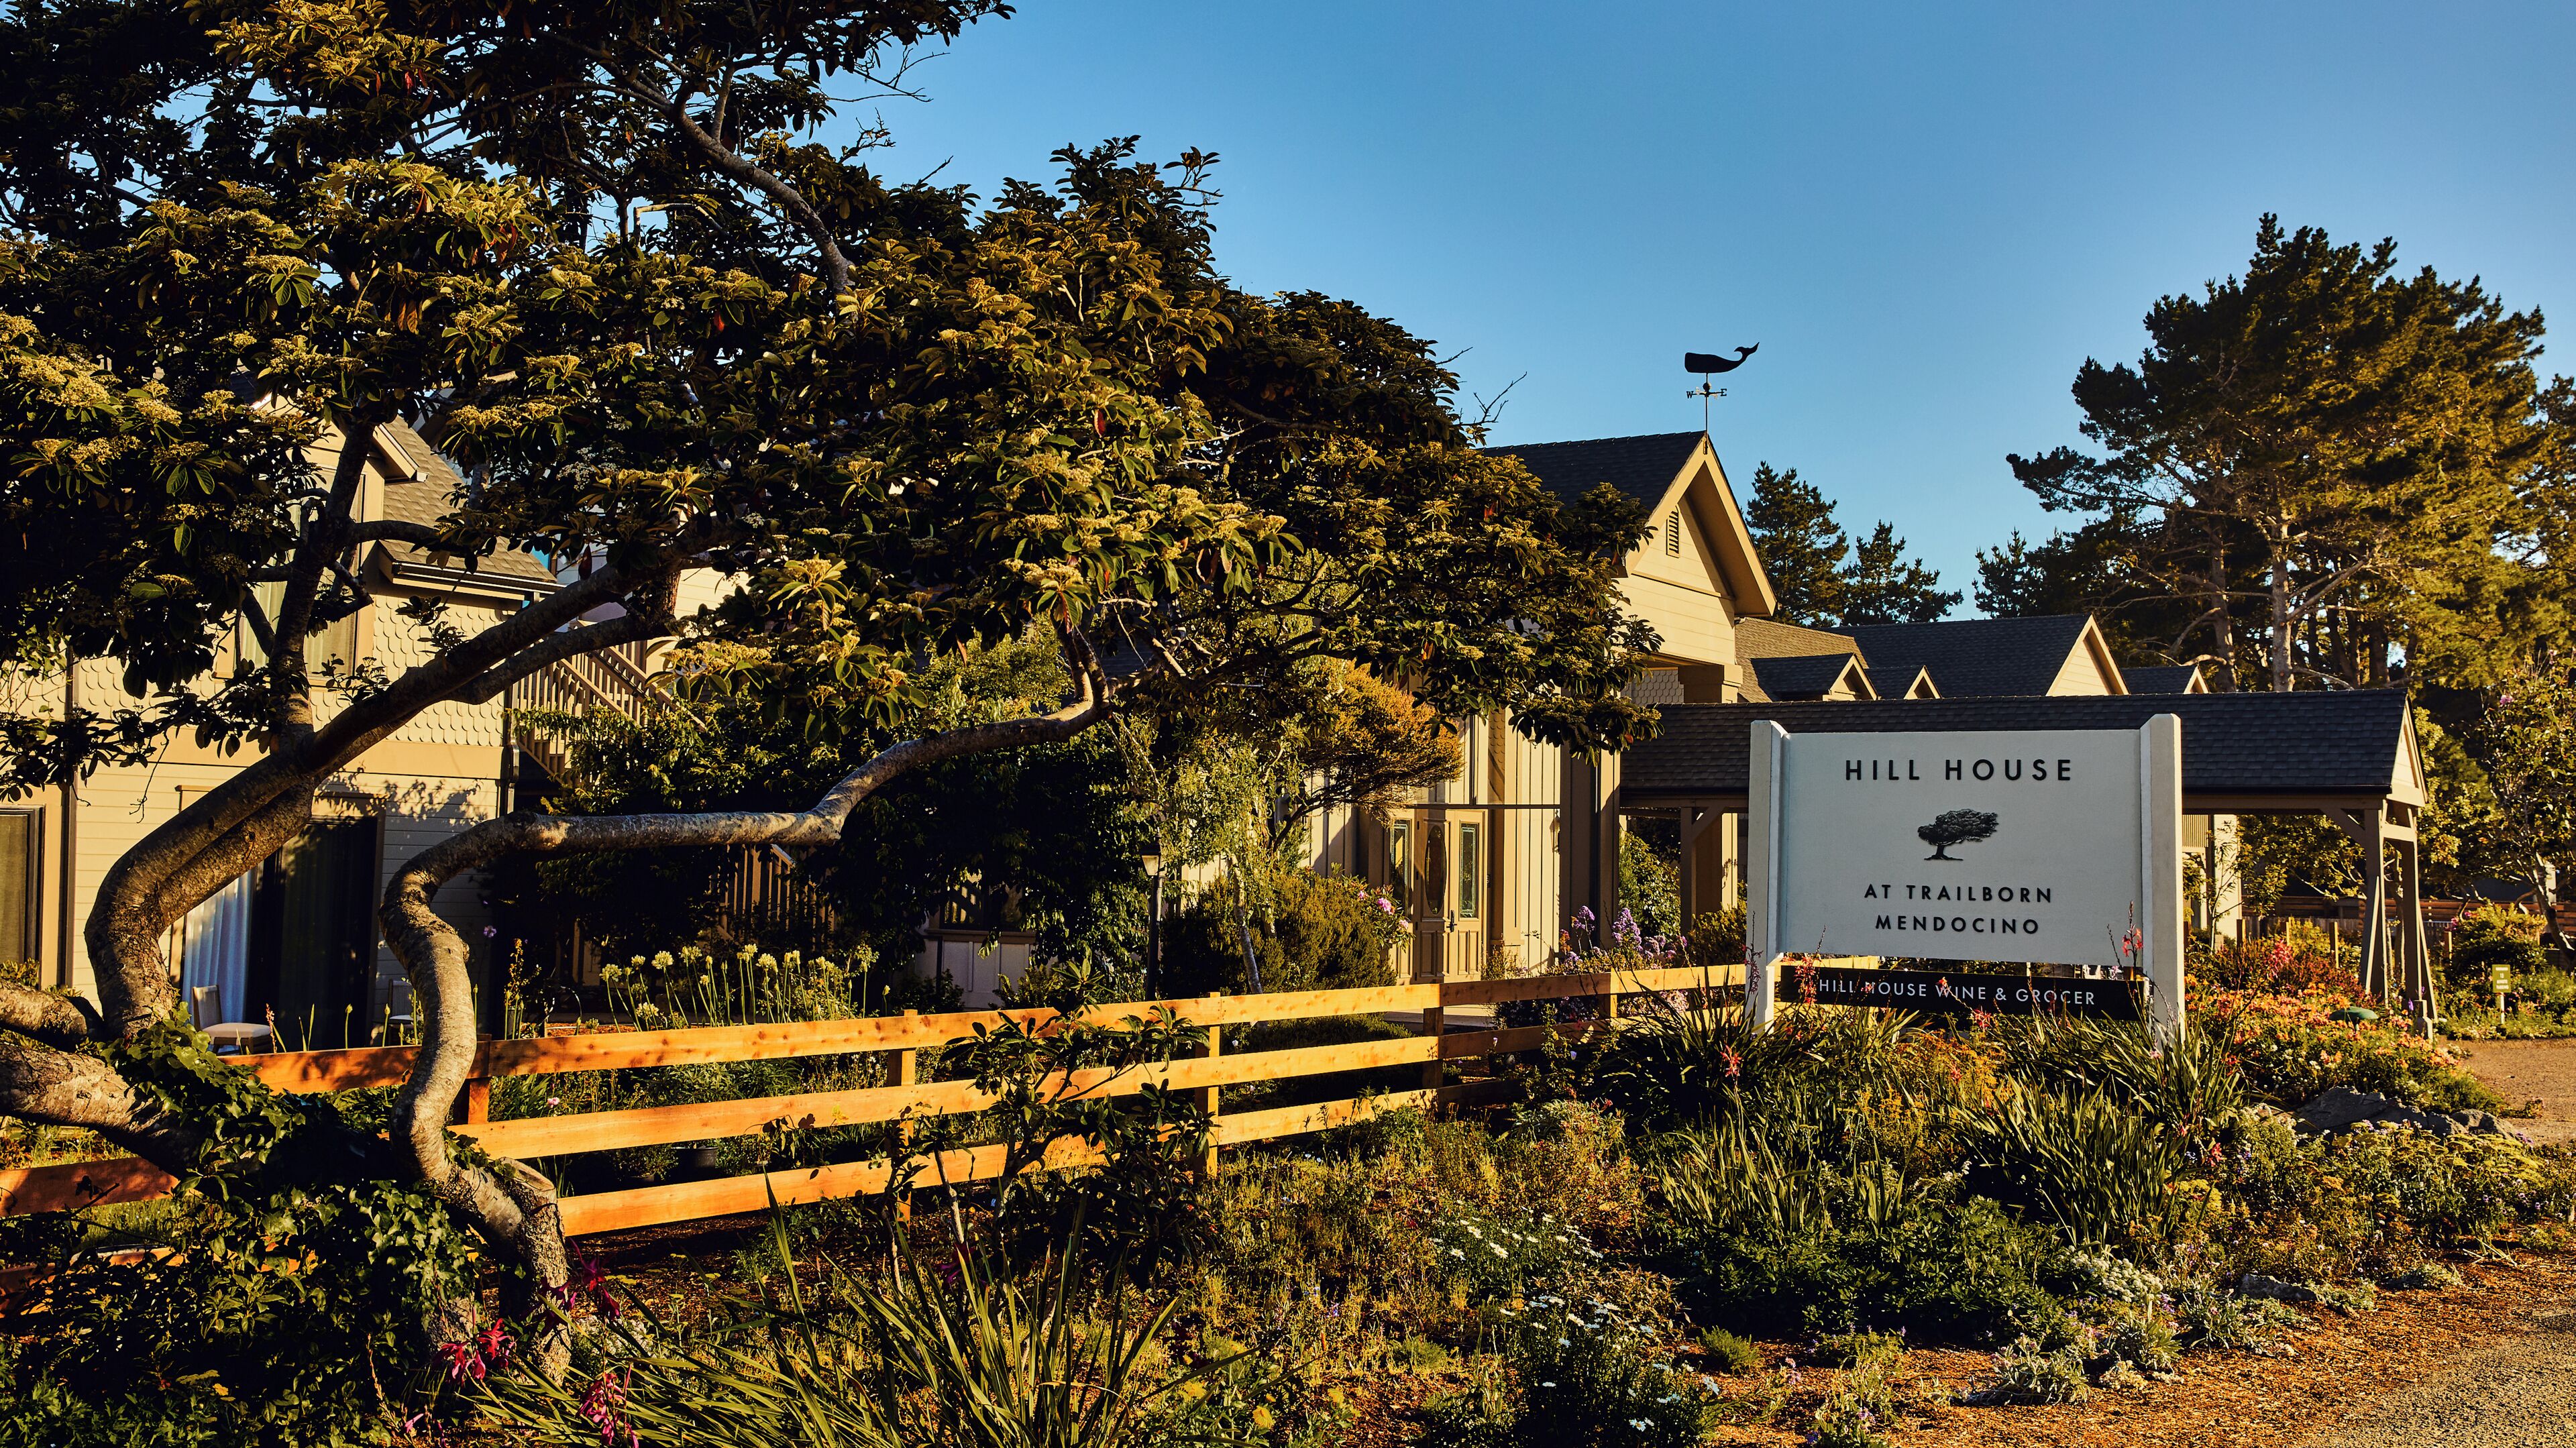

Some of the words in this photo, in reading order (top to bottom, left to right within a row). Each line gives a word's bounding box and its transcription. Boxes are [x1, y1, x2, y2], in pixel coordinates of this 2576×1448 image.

[1686, 390, 1694, 399] W
[1720, 388, 1727, 396] E
[1845, 759, 1919, 781] HILL
[1945, 759, 2070, 781] HOUSE
[1864, 883, 1891, 899] AT
[1906, 885, 2051, 903] TRAILBORN
[1876, 915, 2038, 934] MENDOCINO
[1819, 979, 1856, 993] HILL
[1865, 981, 1927, 997] HOUSE
[1935, 985, 1986, 999] WINE
[1995, 988, 2007, 1001] &
[2016, 989, 2094, 1005] GROCER
